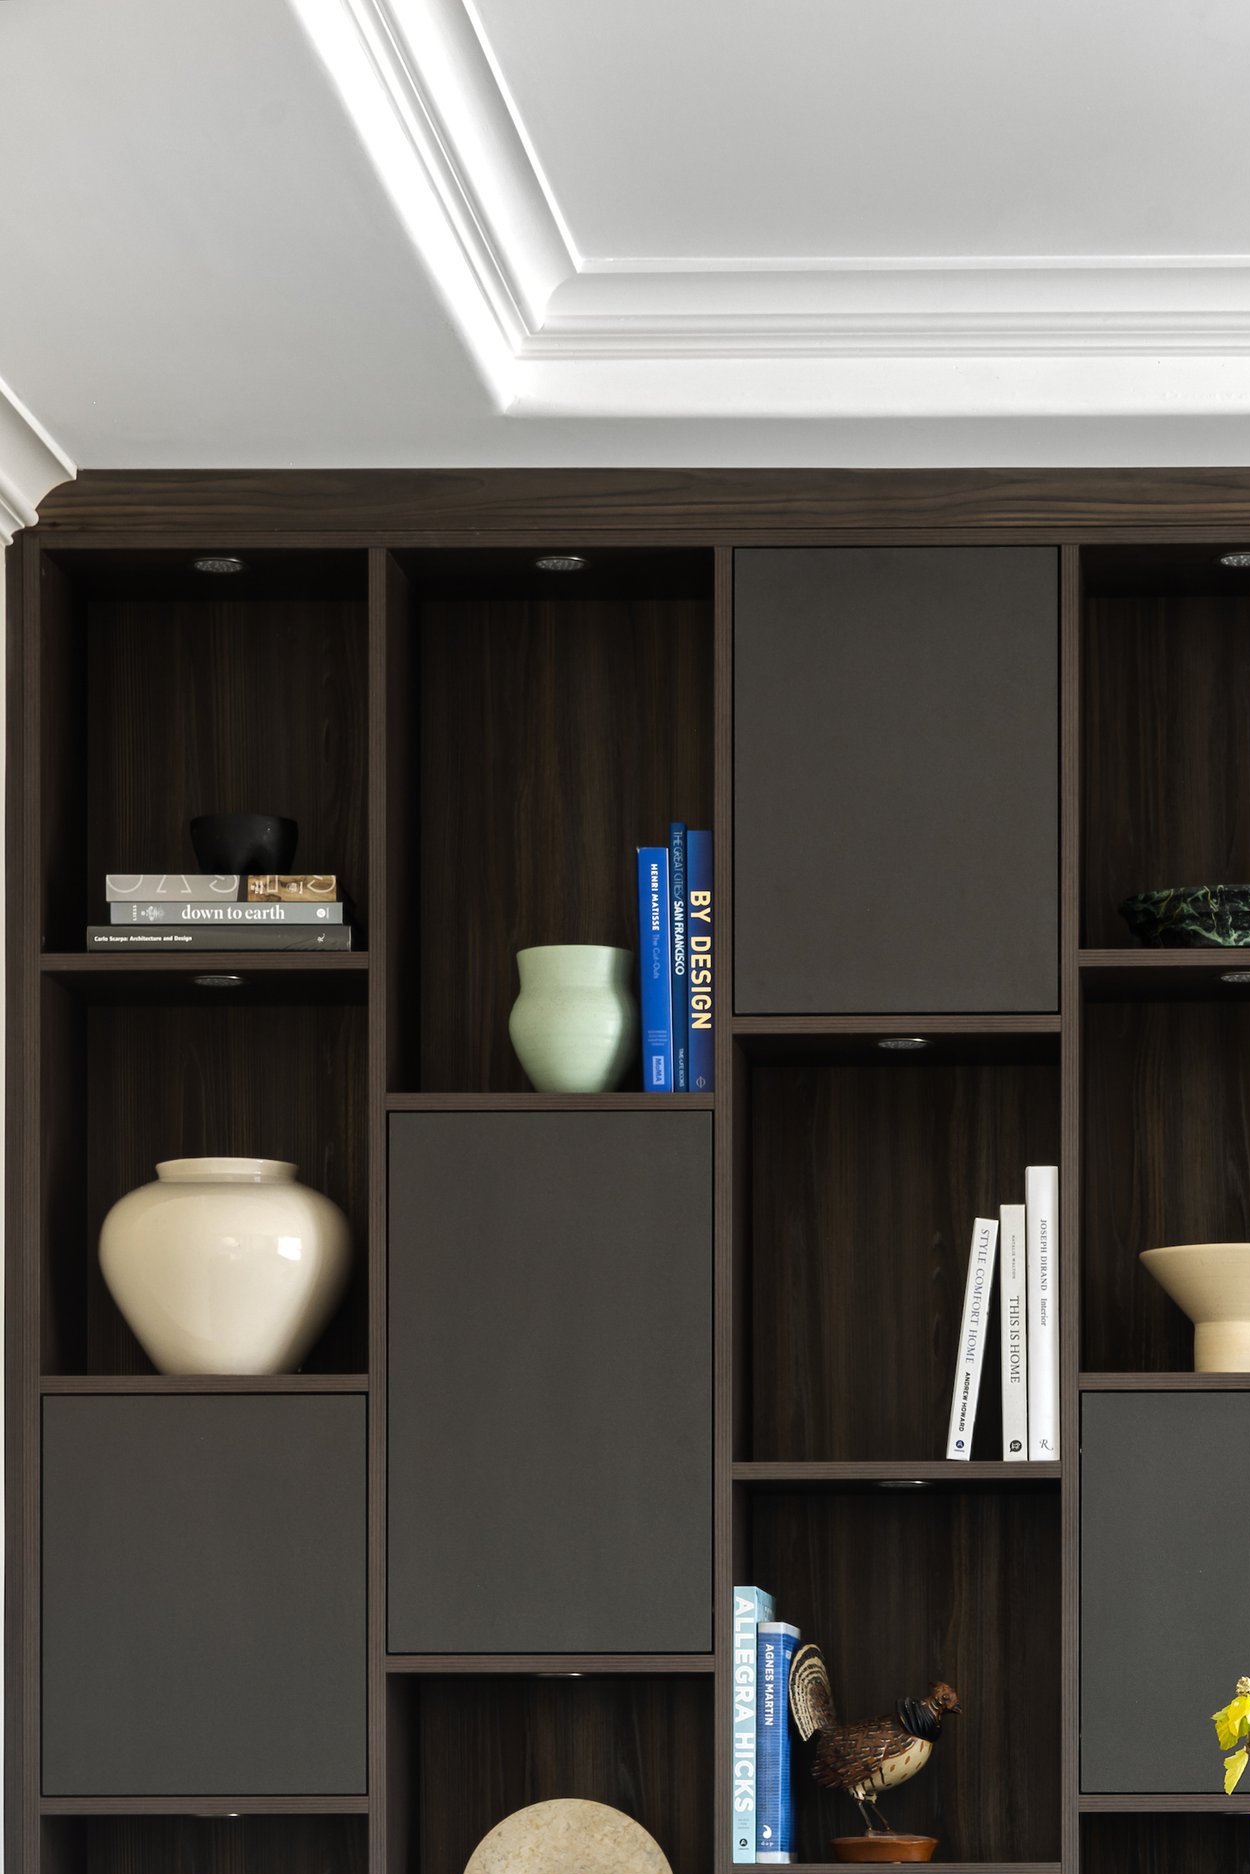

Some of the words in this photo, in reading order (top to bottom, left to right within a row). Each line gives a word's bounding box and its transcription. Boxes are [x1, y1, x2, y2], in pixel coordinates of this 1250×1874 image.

[673, 832, 683, 846] THE
[673, 847, 684, 872] GREAT
[650, 864, 659, 891] HENRI
[181, 904, 224, 919] down
[227, 906, 243, 919] to
[245, 904, 285, 919] earth
[650, 894, 660, 931] MATISSE
[690, 890, 712, 923] BY
[674, 922, 685, 976] FRANCISCO
[690, 936, 712, 1029] DESIGN
[655, 1058, 663, 1082] MoMA
[977, 1228, 990, 1264] STYLE
[1040, 1256, 1048, 1291] DIRAND
[970, 1268, 985, 1326] COMFORT
[1009, 1295, 1020, 1327] THIS
[1040, 1298, 1048, 1326] Interior
[965, 1329, 978, 1364] HOME
[1009, 1329, 1020, 1341] IS
[1009, 1344, 1020, 1383] HOME
[962, 1371, 971, 1401] ANDREW
[958, 1402, 967, 1432] HOWARD
[734, 1595, 755, 1723] ALLEGRA
[764, 1643, 775, 1681] AGNES
[764, 1683, 775, 1726] MARTIN
[734, 1732, 755, 1813] HICKS
